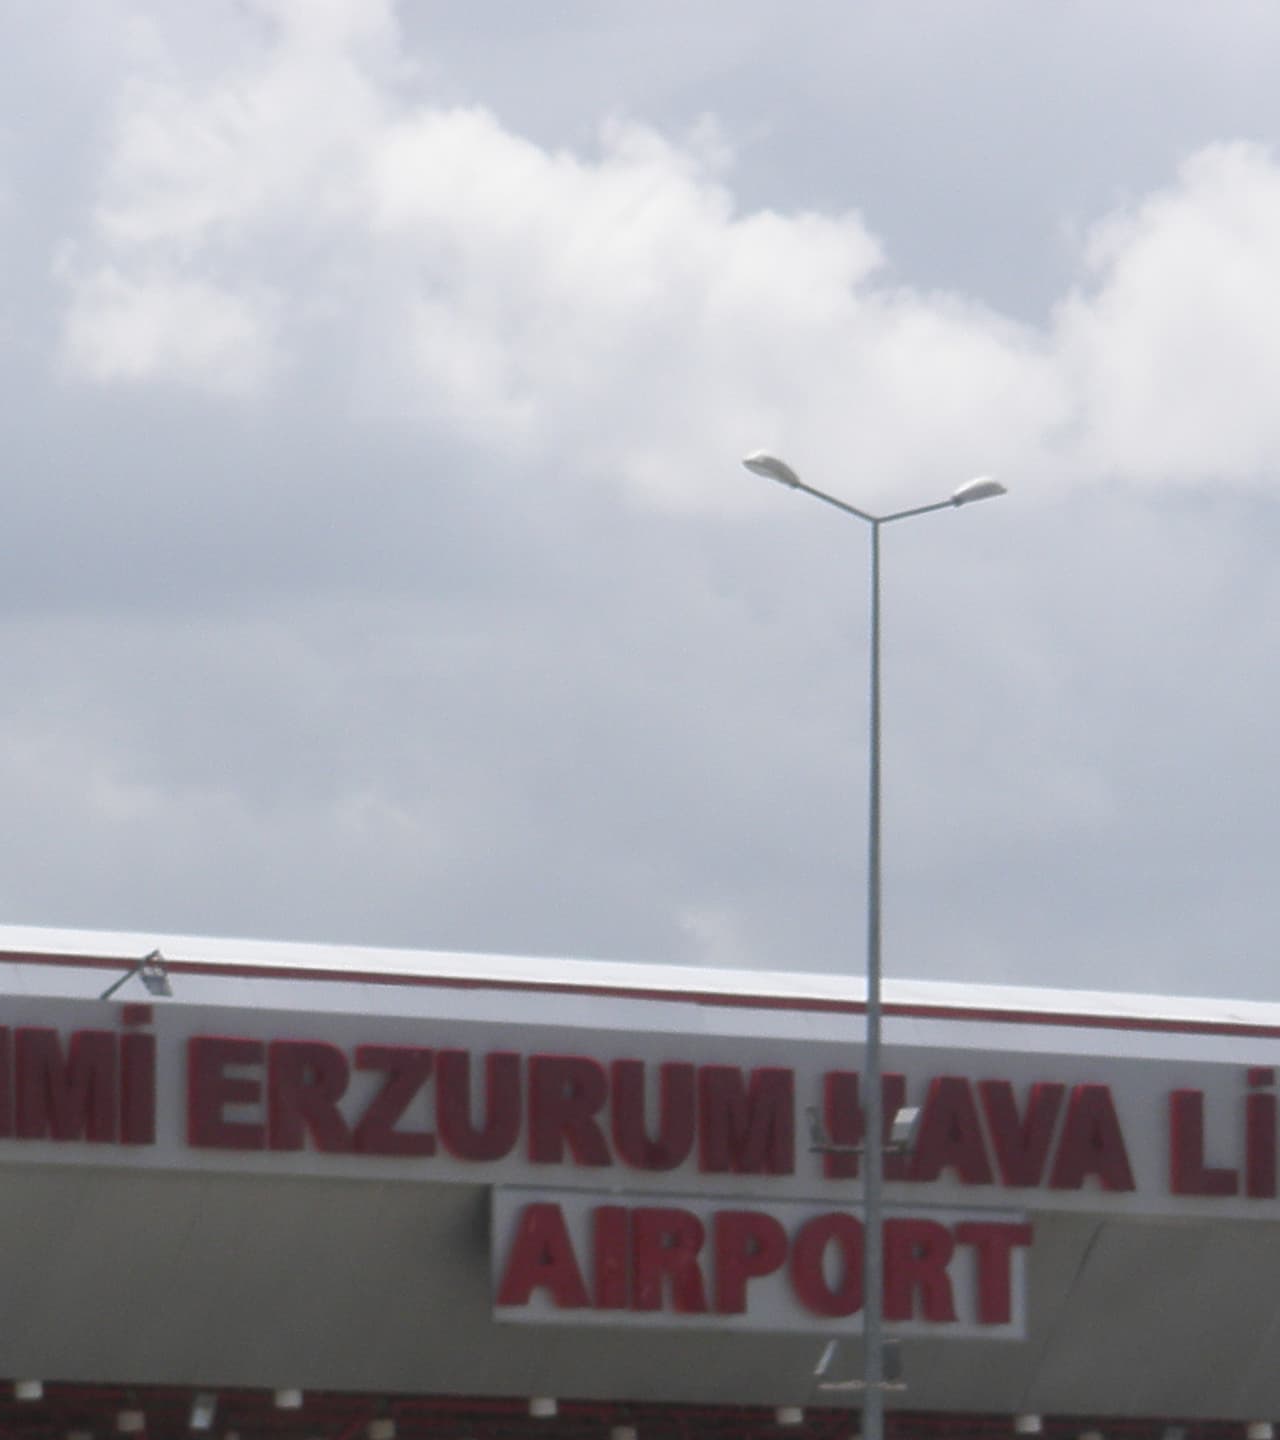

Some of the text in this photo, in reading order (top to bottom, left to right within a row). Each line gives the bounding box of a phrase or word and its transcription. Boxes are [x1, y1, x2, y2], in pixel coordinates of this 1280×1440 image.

[186, 1035, 795, 1176] ERZURUM
[823, 1070, 1136, 1193] HAVA
[495, 1202, 1034, 1326] AIRPORT
